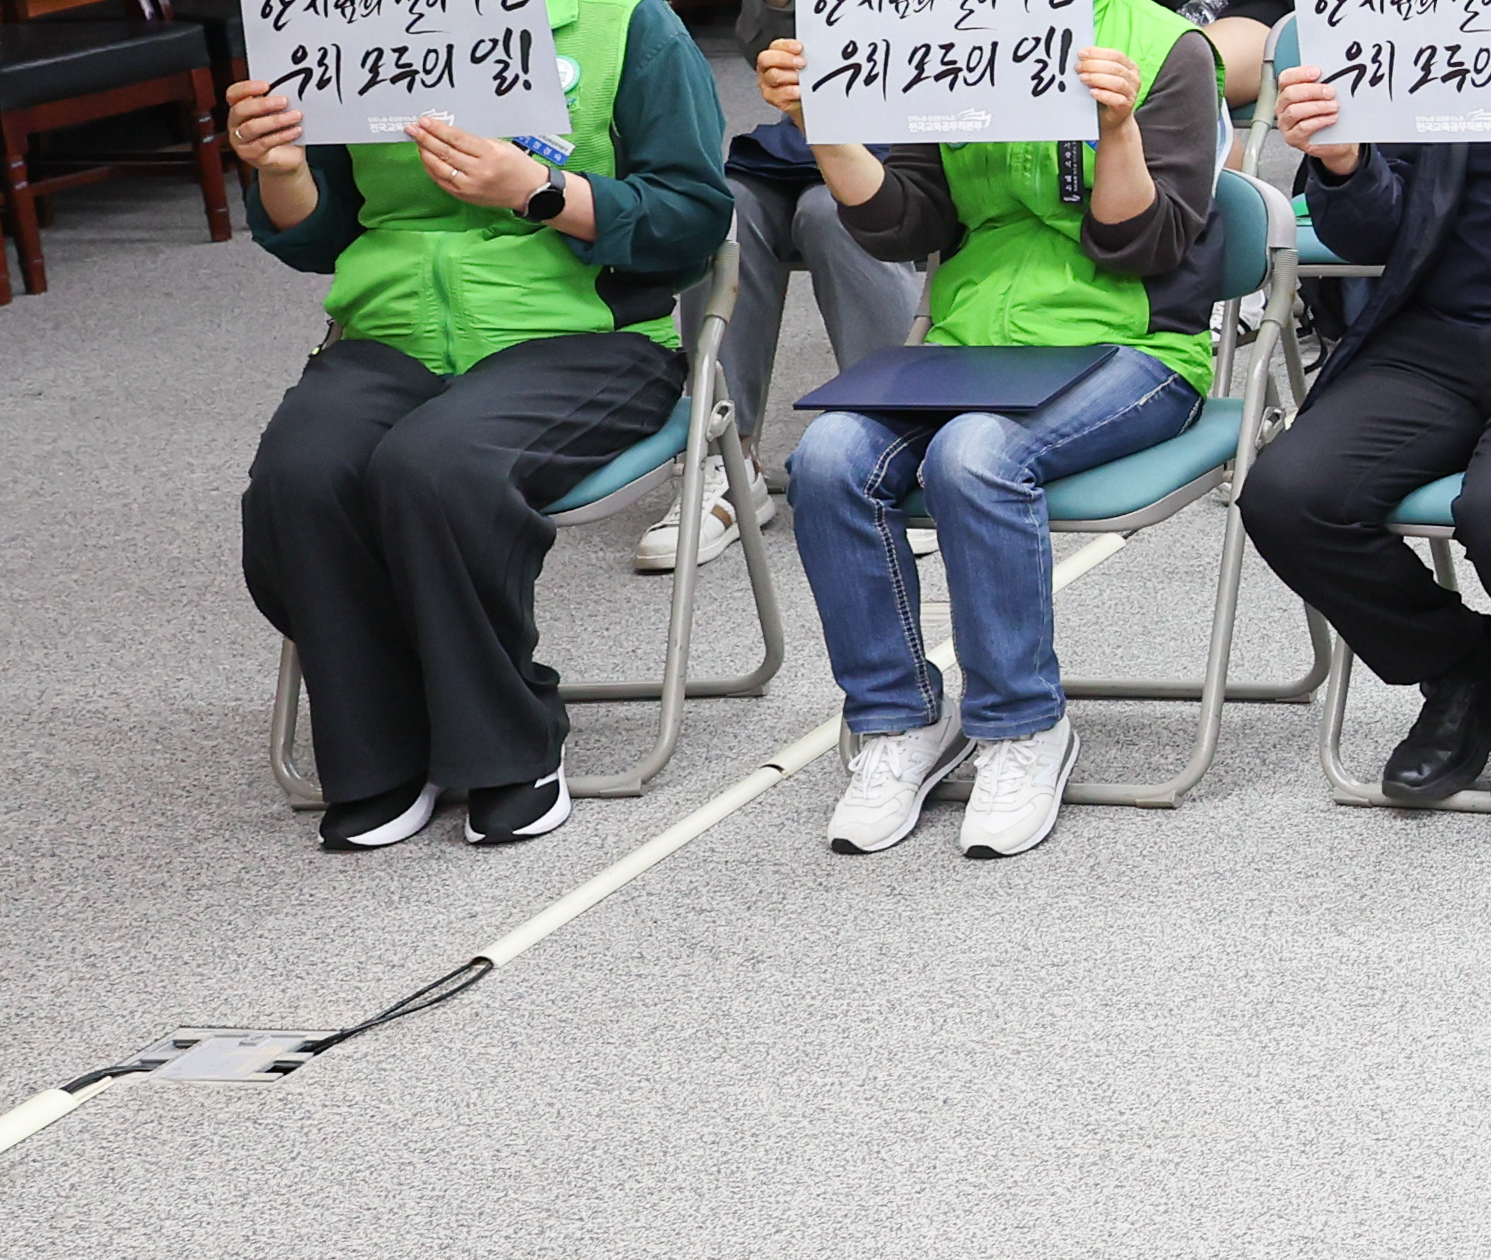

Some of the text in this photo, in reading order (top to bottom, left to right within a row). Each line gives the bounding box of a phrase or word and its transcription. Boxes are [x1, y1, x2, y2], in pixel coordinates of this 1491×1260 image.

[262, 25, 531, 105] 우리 모두의 일!
[810, 25, 1072, 101] 우리 모두의 일!
[1315, 41, 1395, 101] 우리
